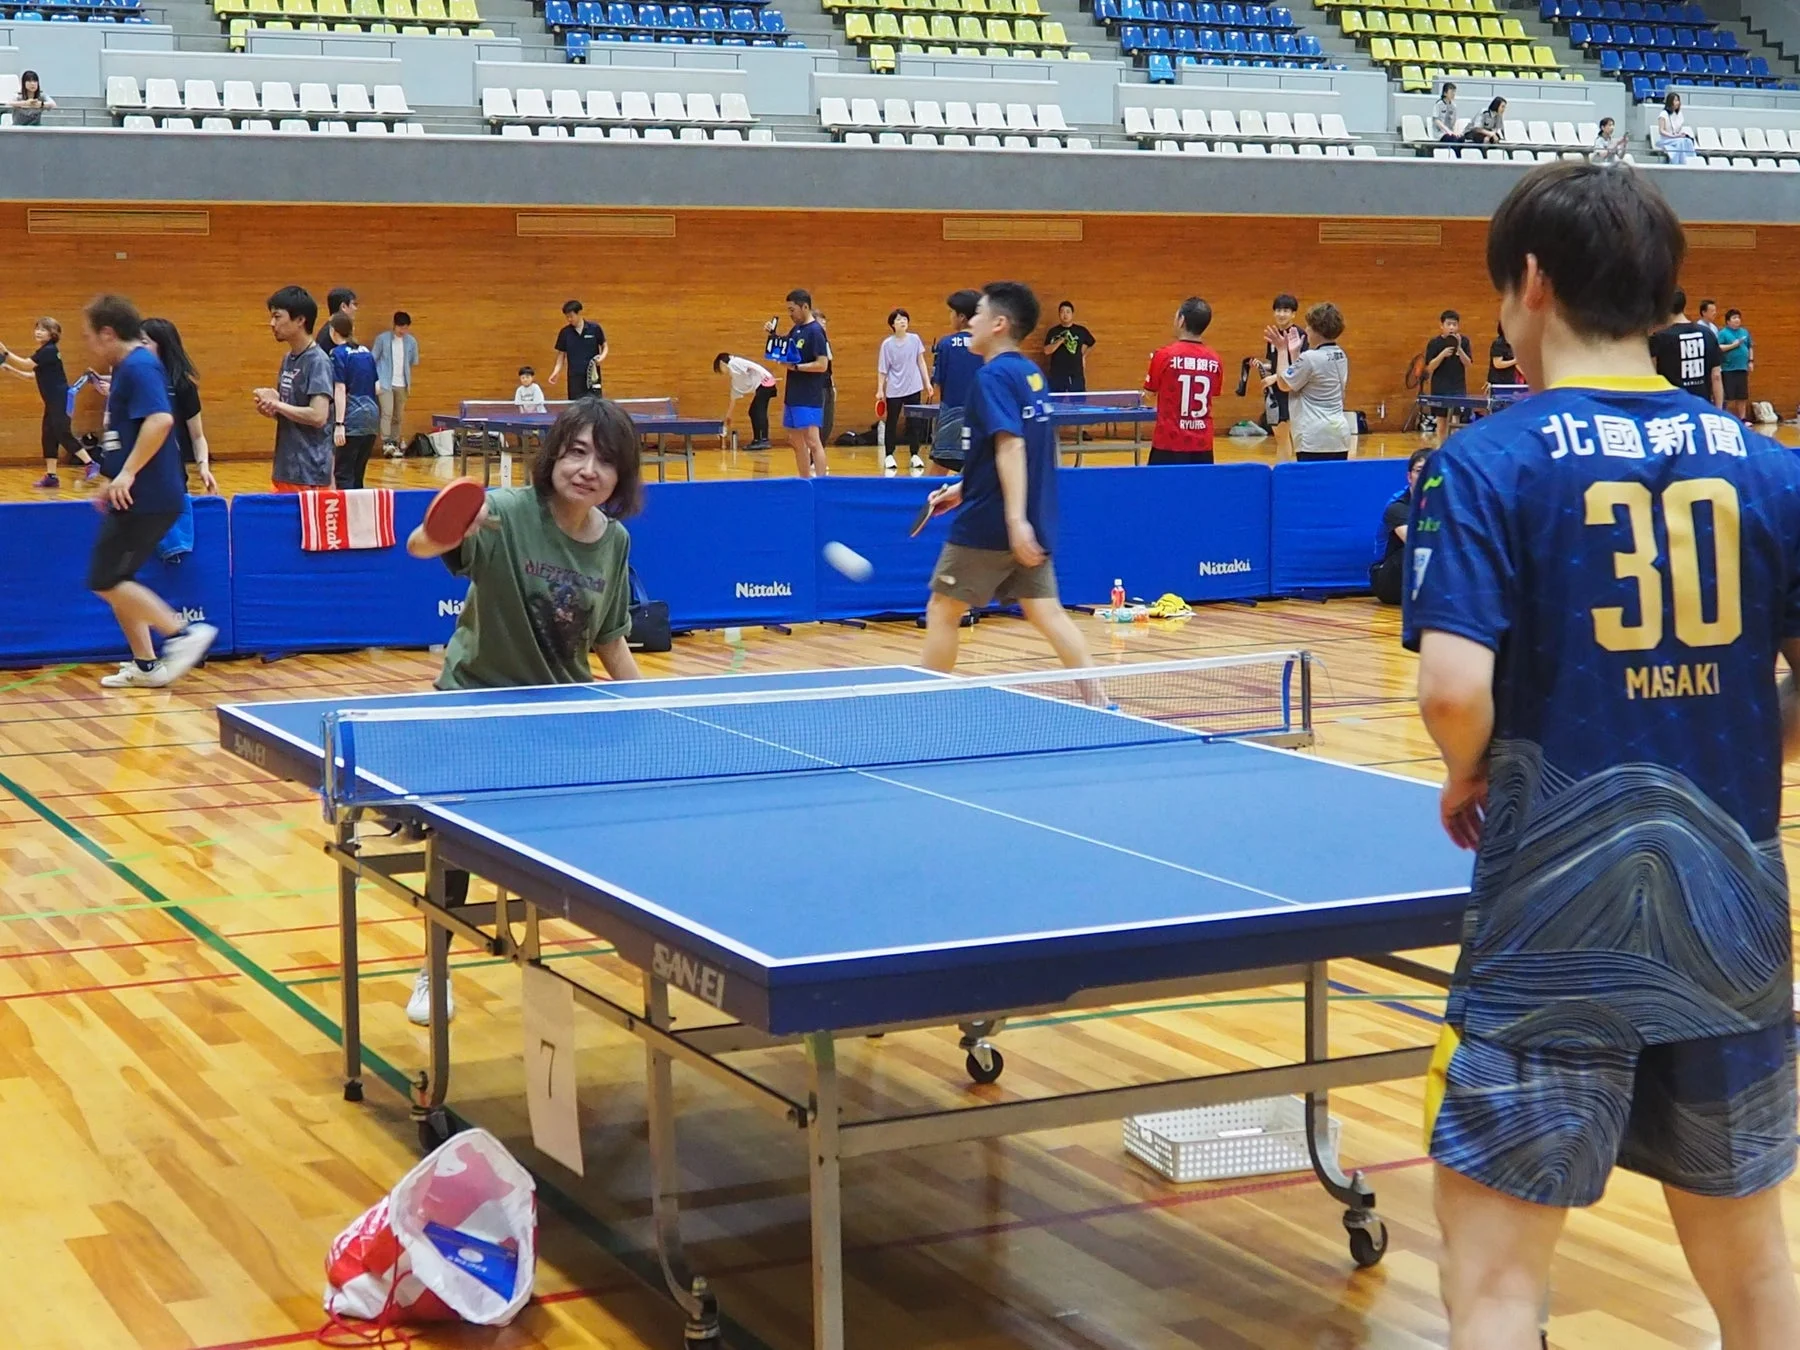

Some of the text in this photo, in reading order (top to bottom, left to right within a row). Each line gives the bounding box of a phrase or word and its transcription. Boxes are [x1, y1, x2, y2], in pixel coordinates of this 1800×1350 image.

[1170, 356, 1219, 373] 北國銀行
[1178, 374, 1210, 418] 13
[1541, 412, 1748, 459] 北國新聞
[1200, 558, 1251, 576] Nittaku
[1584, 477, 1742, 651] 30
[736, 581, 792, 598] Nittaku
[1625, 662, 1720, 700] MASAKI
[652, 942, 725, 1008] SAN-EI
[540, 1038, 556, 1099] 7
